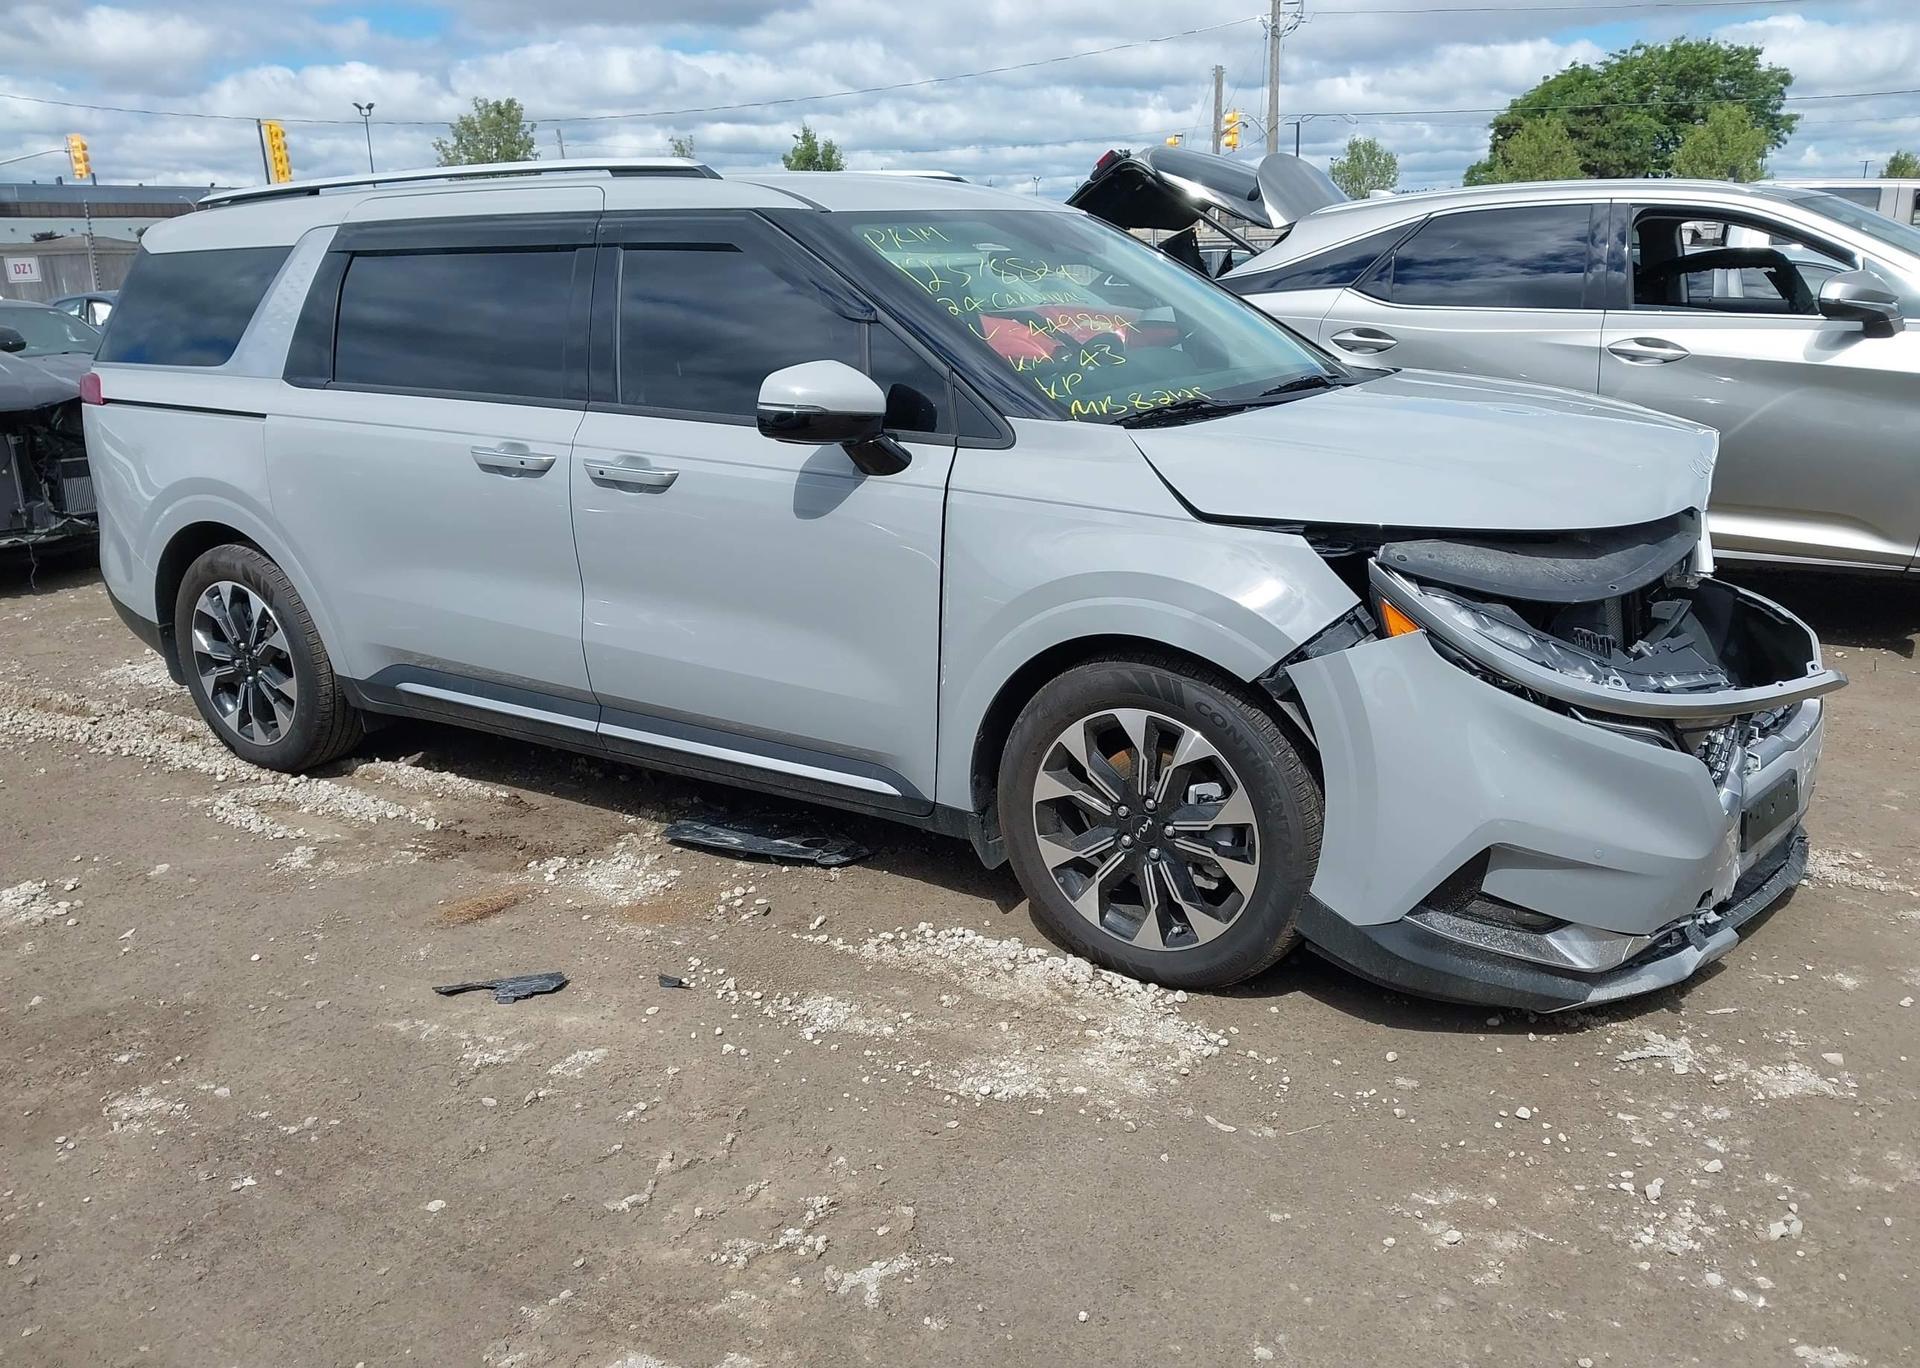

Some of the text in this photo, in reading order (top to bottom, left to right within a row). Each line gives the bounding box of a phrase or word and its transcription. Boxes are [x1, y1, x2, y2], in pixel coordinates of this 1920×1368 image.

[13, 263, 33, 275] DZ1
[936, 297, 986, 316] 24
[1034, 373, 1083, 400] KP
